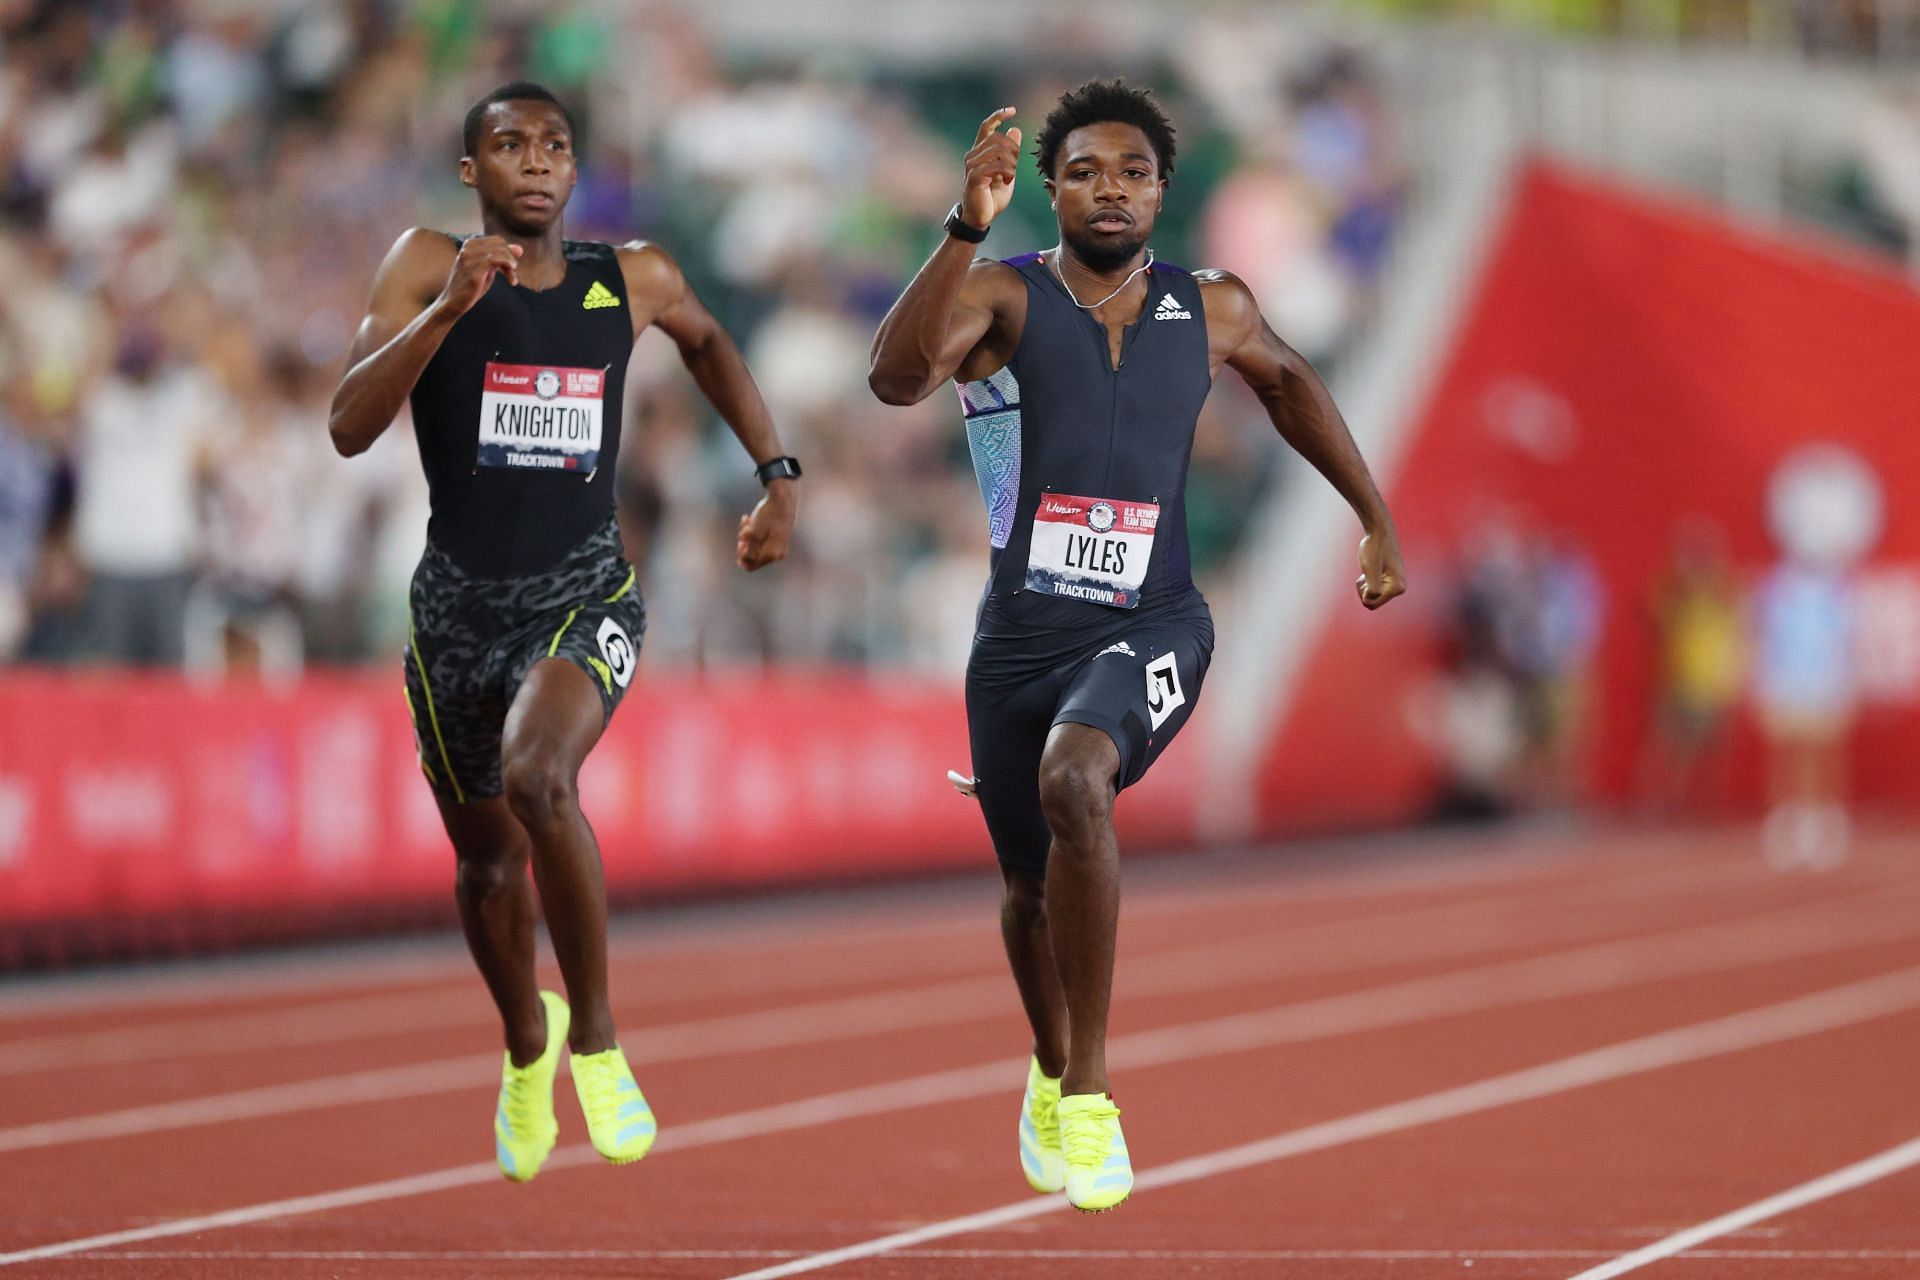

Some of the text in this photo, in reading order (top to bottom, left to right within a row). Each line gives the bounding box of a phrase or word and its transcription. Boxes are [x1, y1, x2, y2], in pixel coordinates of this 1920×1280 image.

[1154, 309, 1192, 320] adidas
[494, 403, 591, 440] KNIGHTON
[1123, 516, 1140, 527] TEAM
[1064, 533, 1127, 575] LYLES
[606, 633, 630, 676] 6
[1148, 666, 1176, 714] 5
